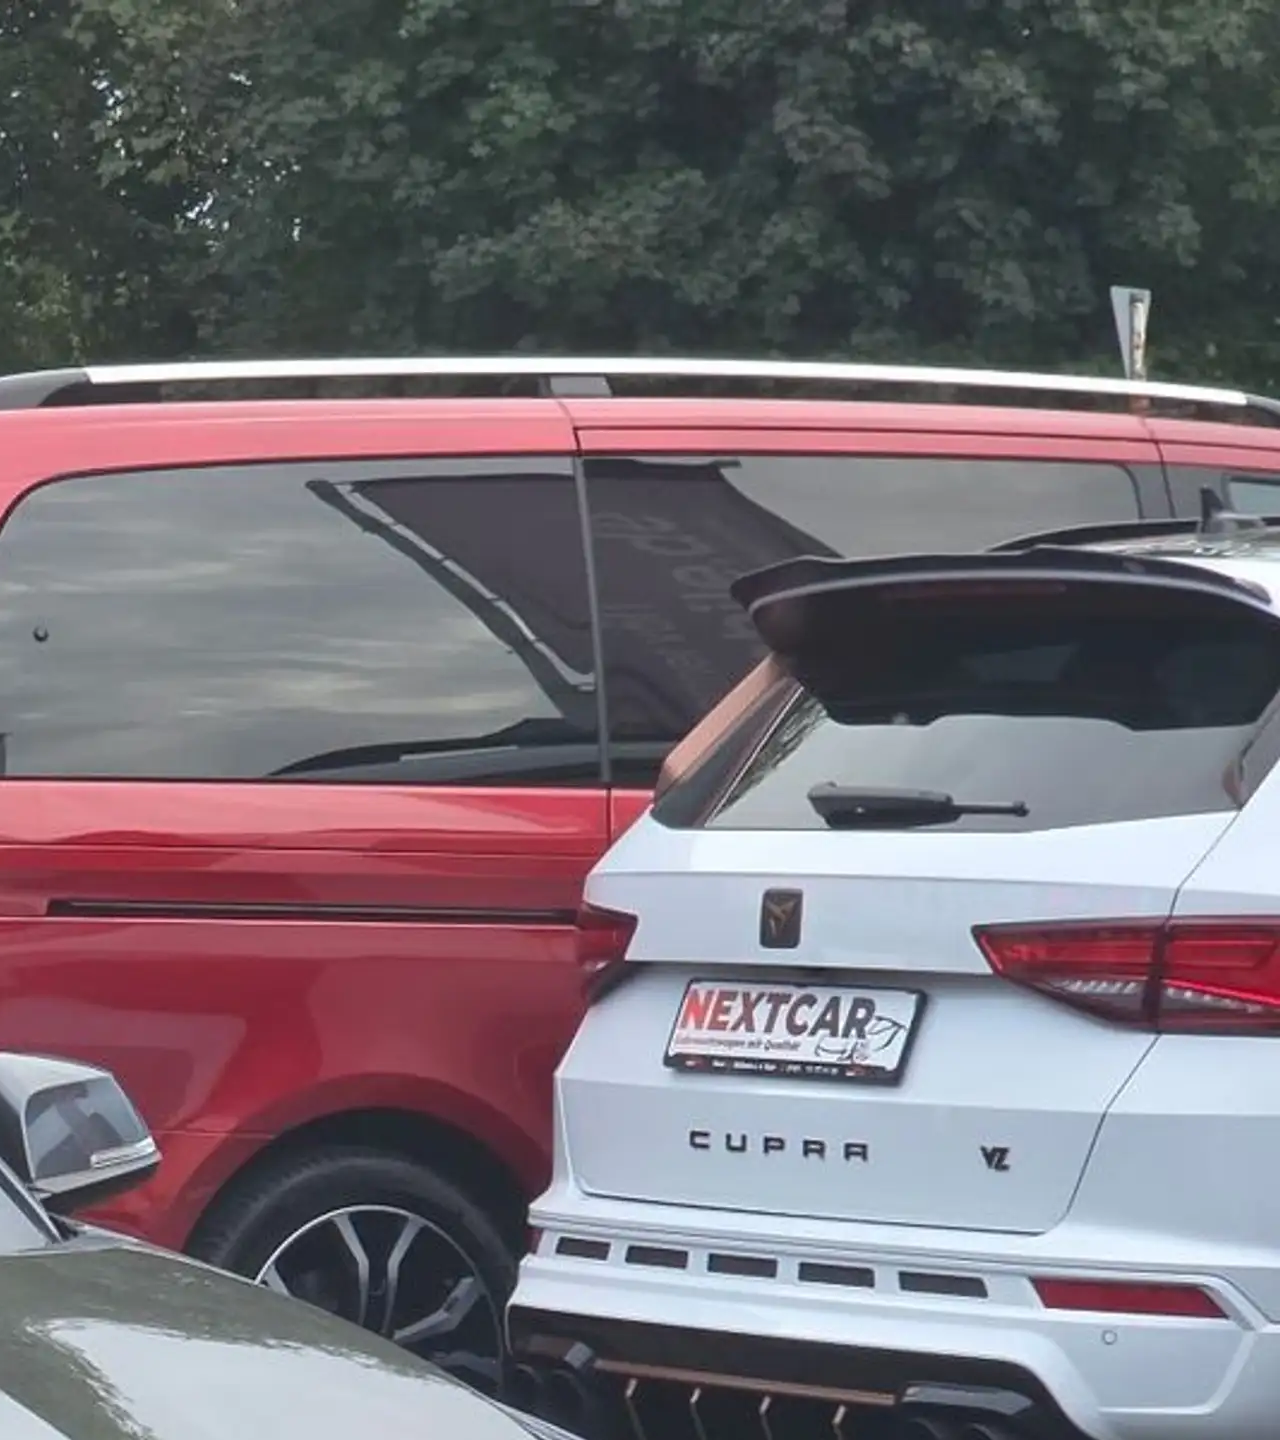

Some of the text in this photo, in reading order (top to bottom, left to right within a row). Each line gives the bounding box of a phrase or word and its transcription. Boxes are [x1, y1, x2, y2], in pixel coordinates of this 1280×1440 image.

[680, 988, 876, 1039] NEXTCAR
[689, 1130, 869, 1162] CUPRA
[980, 1145, 1011, 1172] VZ
